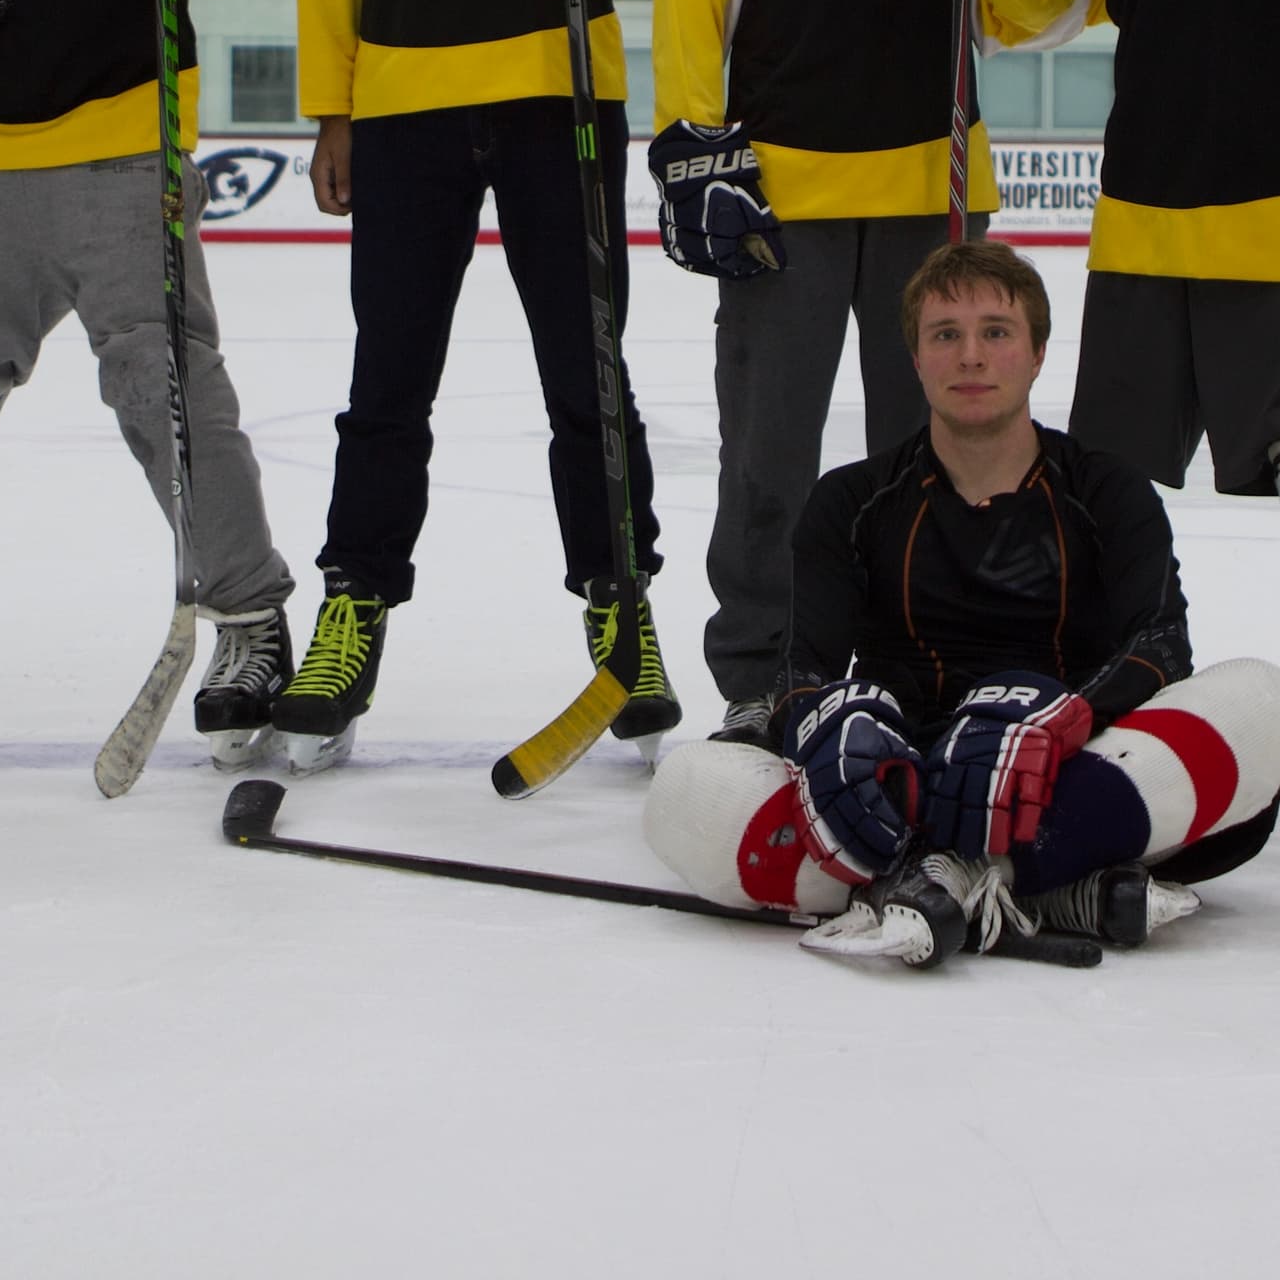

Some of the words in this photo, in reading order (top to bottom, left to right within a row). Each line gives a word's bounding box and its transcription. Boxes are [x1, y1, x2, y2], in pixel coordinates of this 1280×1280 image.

[666, 148, 759, 184] BAUE
[999, 183, 1100, 208] HOPEDICS
[591, 295, 624, 481] CCM
[797, 683, 904, 752] BAUE
